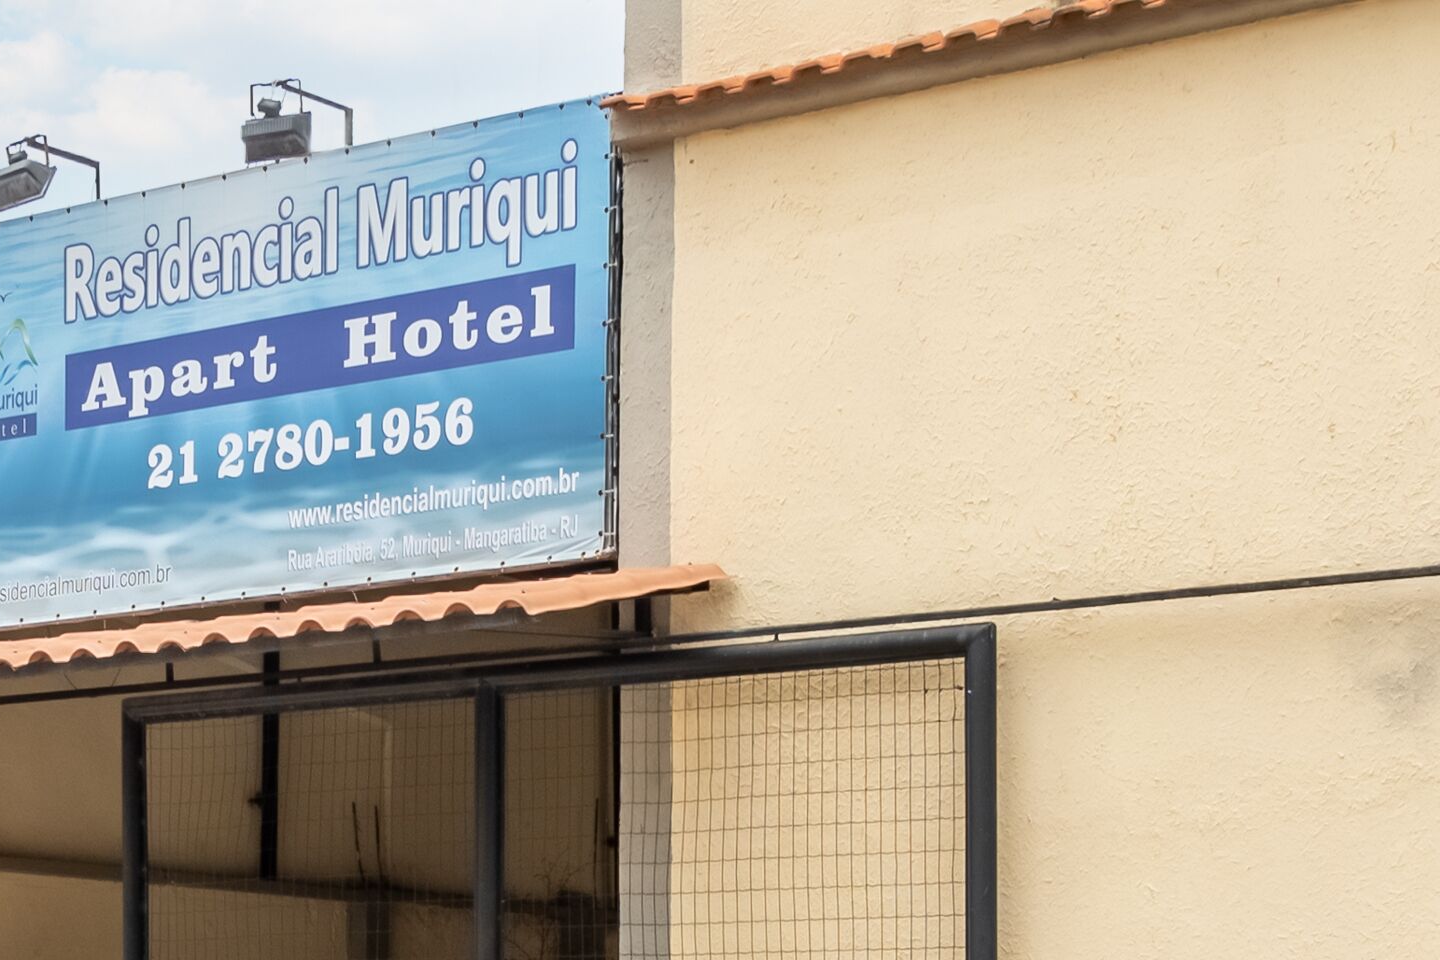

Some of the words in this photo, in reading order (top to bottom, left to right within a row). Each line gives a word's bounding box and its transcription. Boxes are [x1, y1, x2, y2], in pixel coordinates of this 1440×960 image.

[64, 187, 339, 324] Residencial
[356, 138, 578, 268] Muriqui
[81, 335, 277, 418] Apart
[343, 285, 555, 368] Hotel
[147, 440, 199, 489] 21
[217, 397, 474, 479] 2780-1956
[287, 549, 312, 572] Rua
[379, 537, 399, 561] 52,
[402, 530, 452, 558] Muriqui
[464, 519, 547, 552] Mangaratiba
[560, 514, 579, 540] RJ
[288, 467, 580, 529] www.residencialmuriqui.com.br
